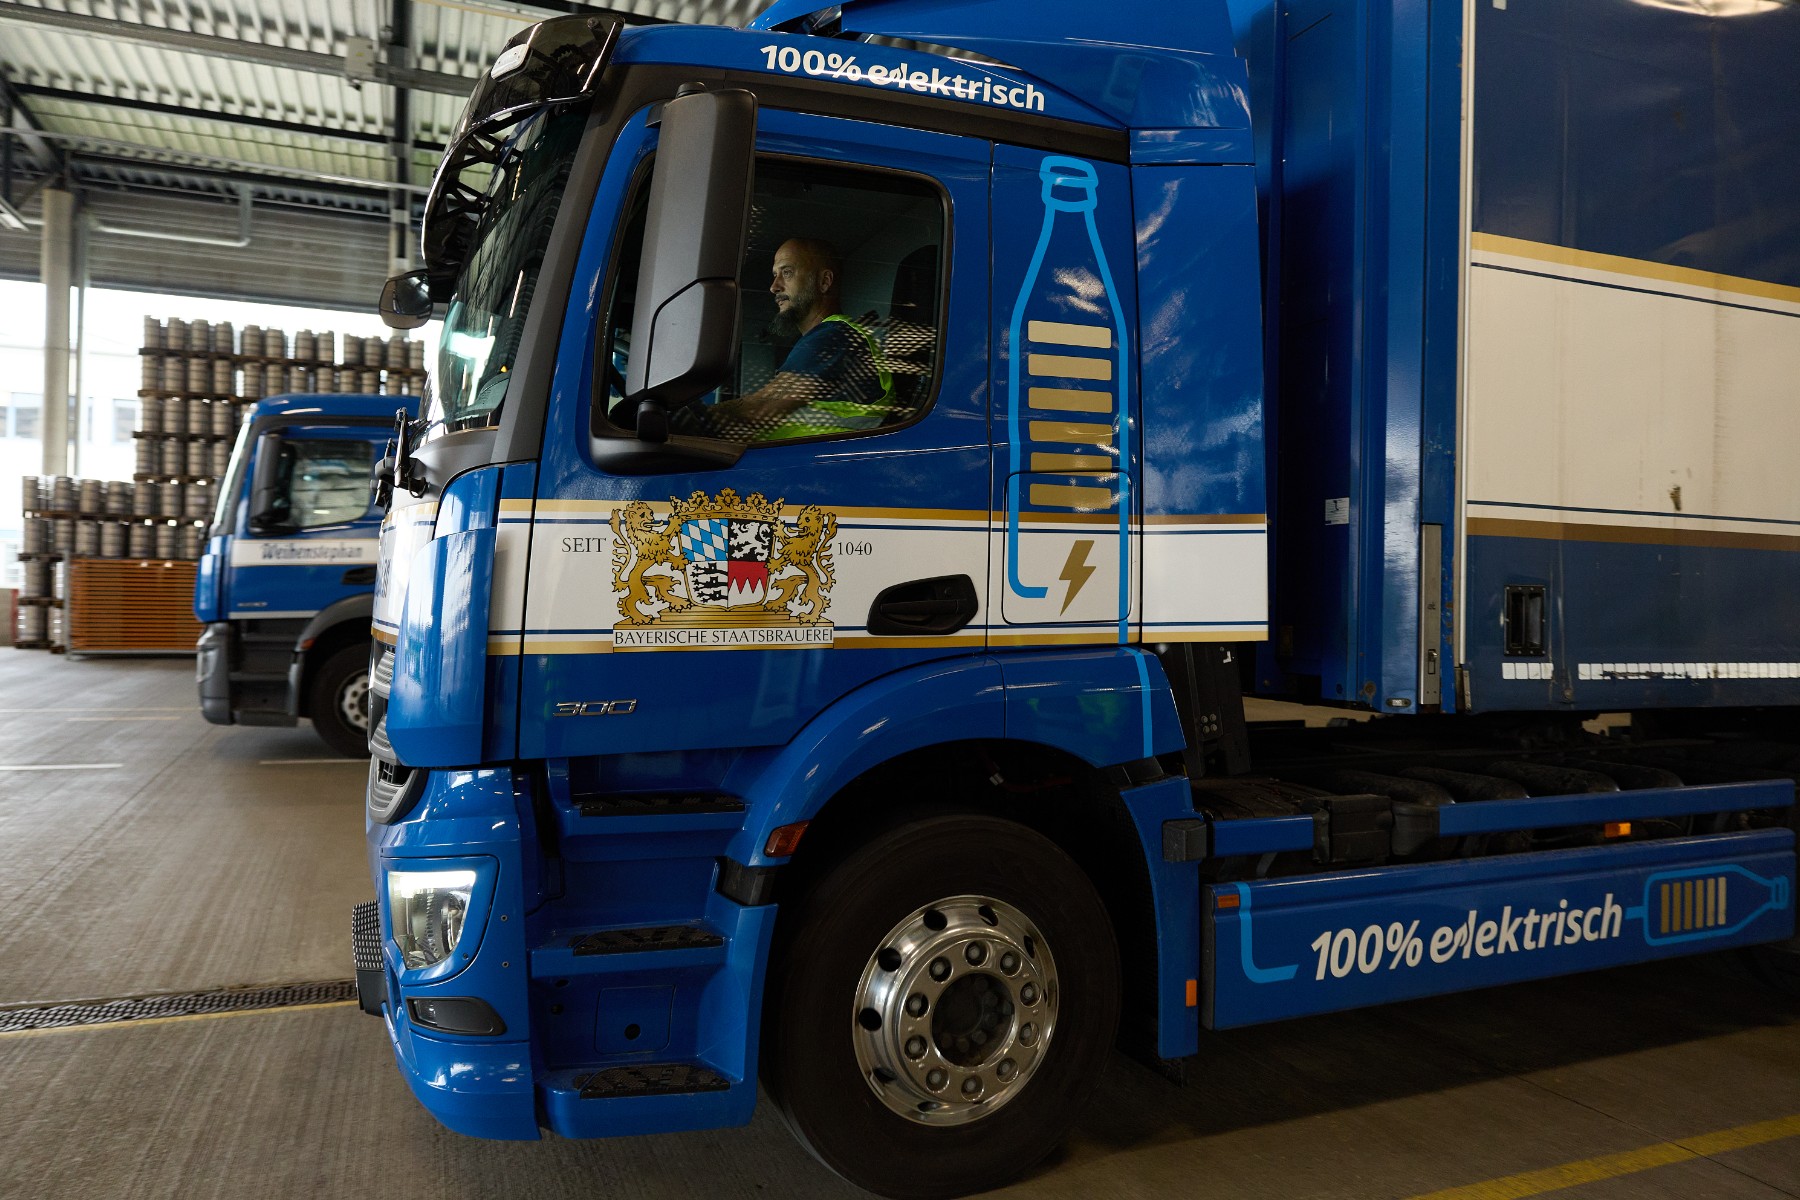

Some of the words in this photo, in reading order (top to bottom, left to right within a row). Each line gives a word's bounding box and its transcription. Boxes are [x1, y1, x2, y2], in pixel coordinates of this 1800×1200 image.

[760, 45, 862, 82] 100%
[561, 537, 606, 553] SEIT
[837, 541, 873, 556] 1040
[614, 630, 707, 645] BAYERISCHE
[711, 628, 833, 644] STAATSBRAUEREI
[553, 699, 637, 717] 300
[1311, 920, 1423, 981] 100%
